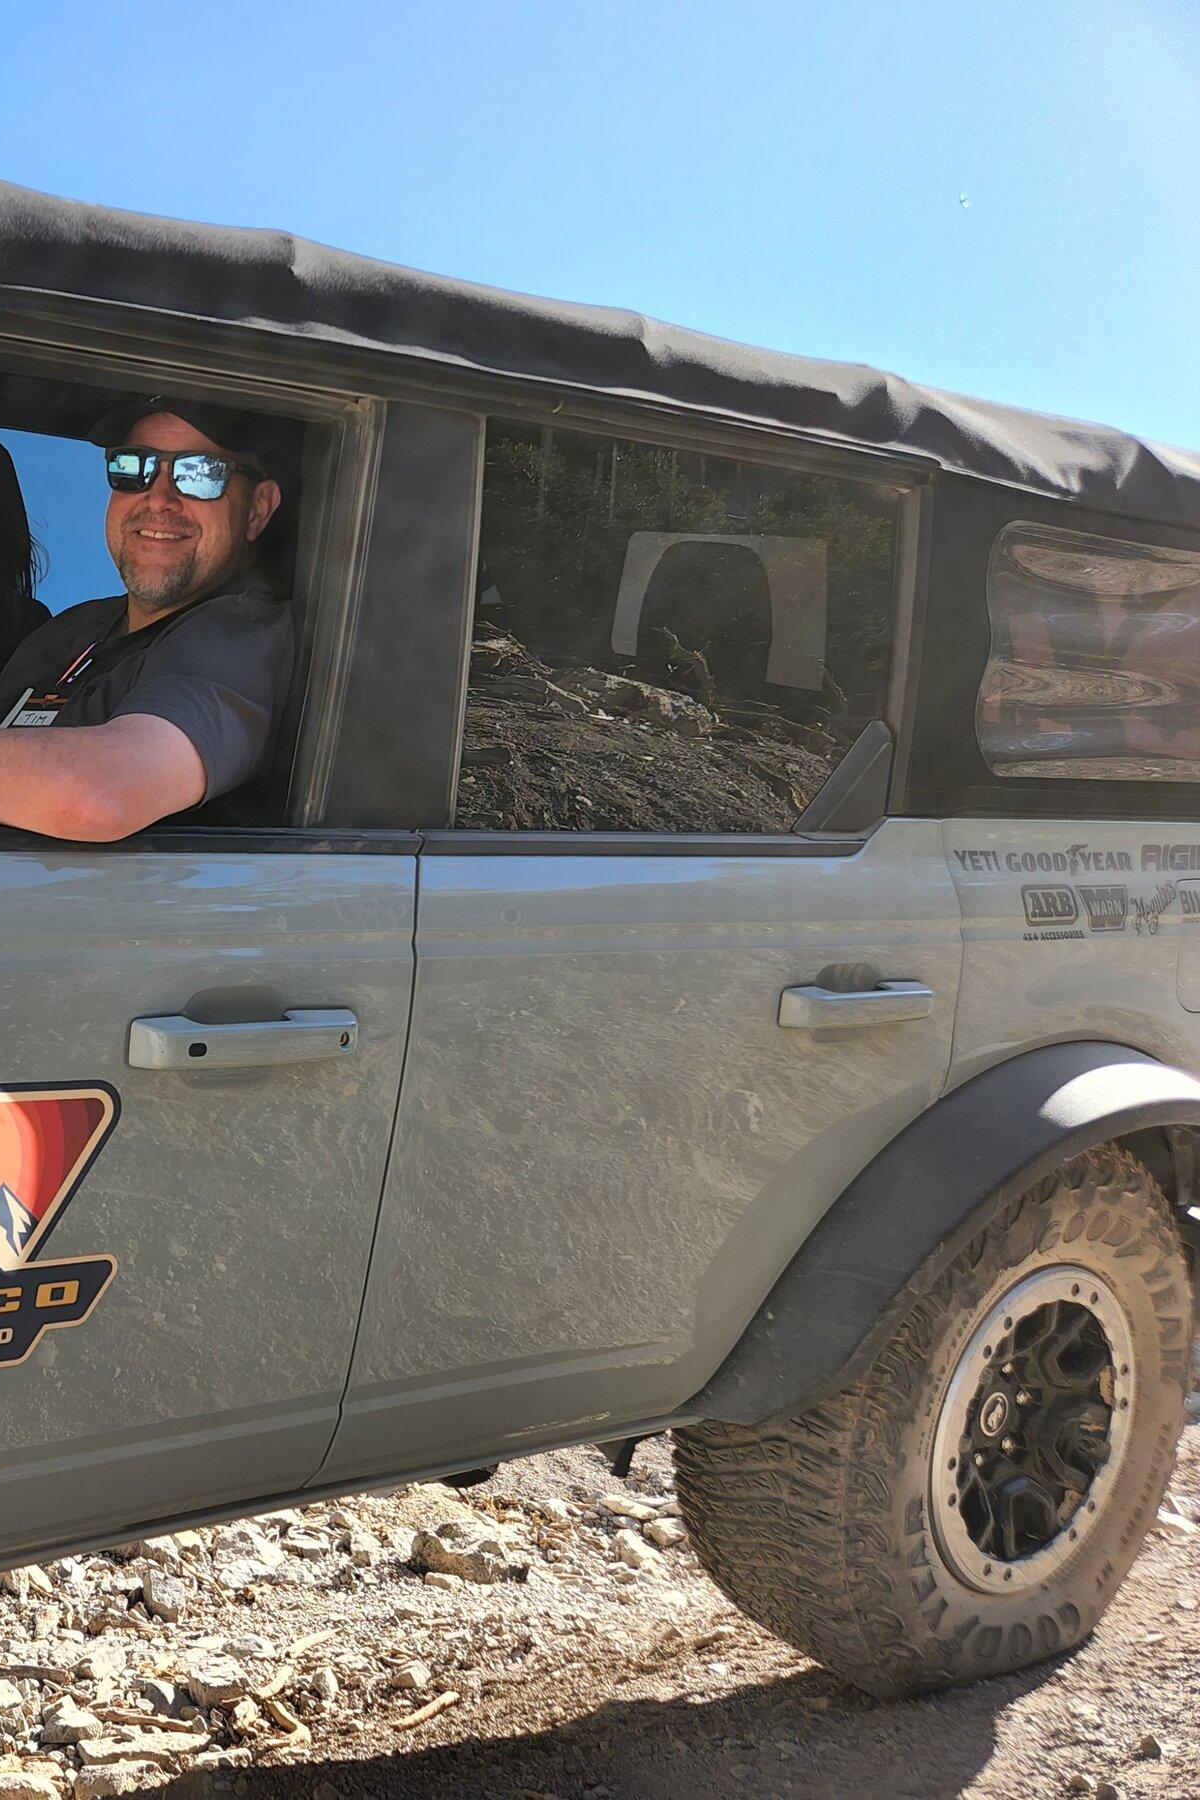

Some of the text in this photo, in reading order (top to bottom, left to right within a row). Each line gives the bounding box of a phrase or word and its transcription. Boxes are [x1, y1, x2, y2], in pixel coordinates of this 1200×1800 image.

[23, 712, 48, 725] TIM
[953, 844, 1200, 874] YETI GOODYEAR RIGI
[1028, 891, 1075, 919] ARB
